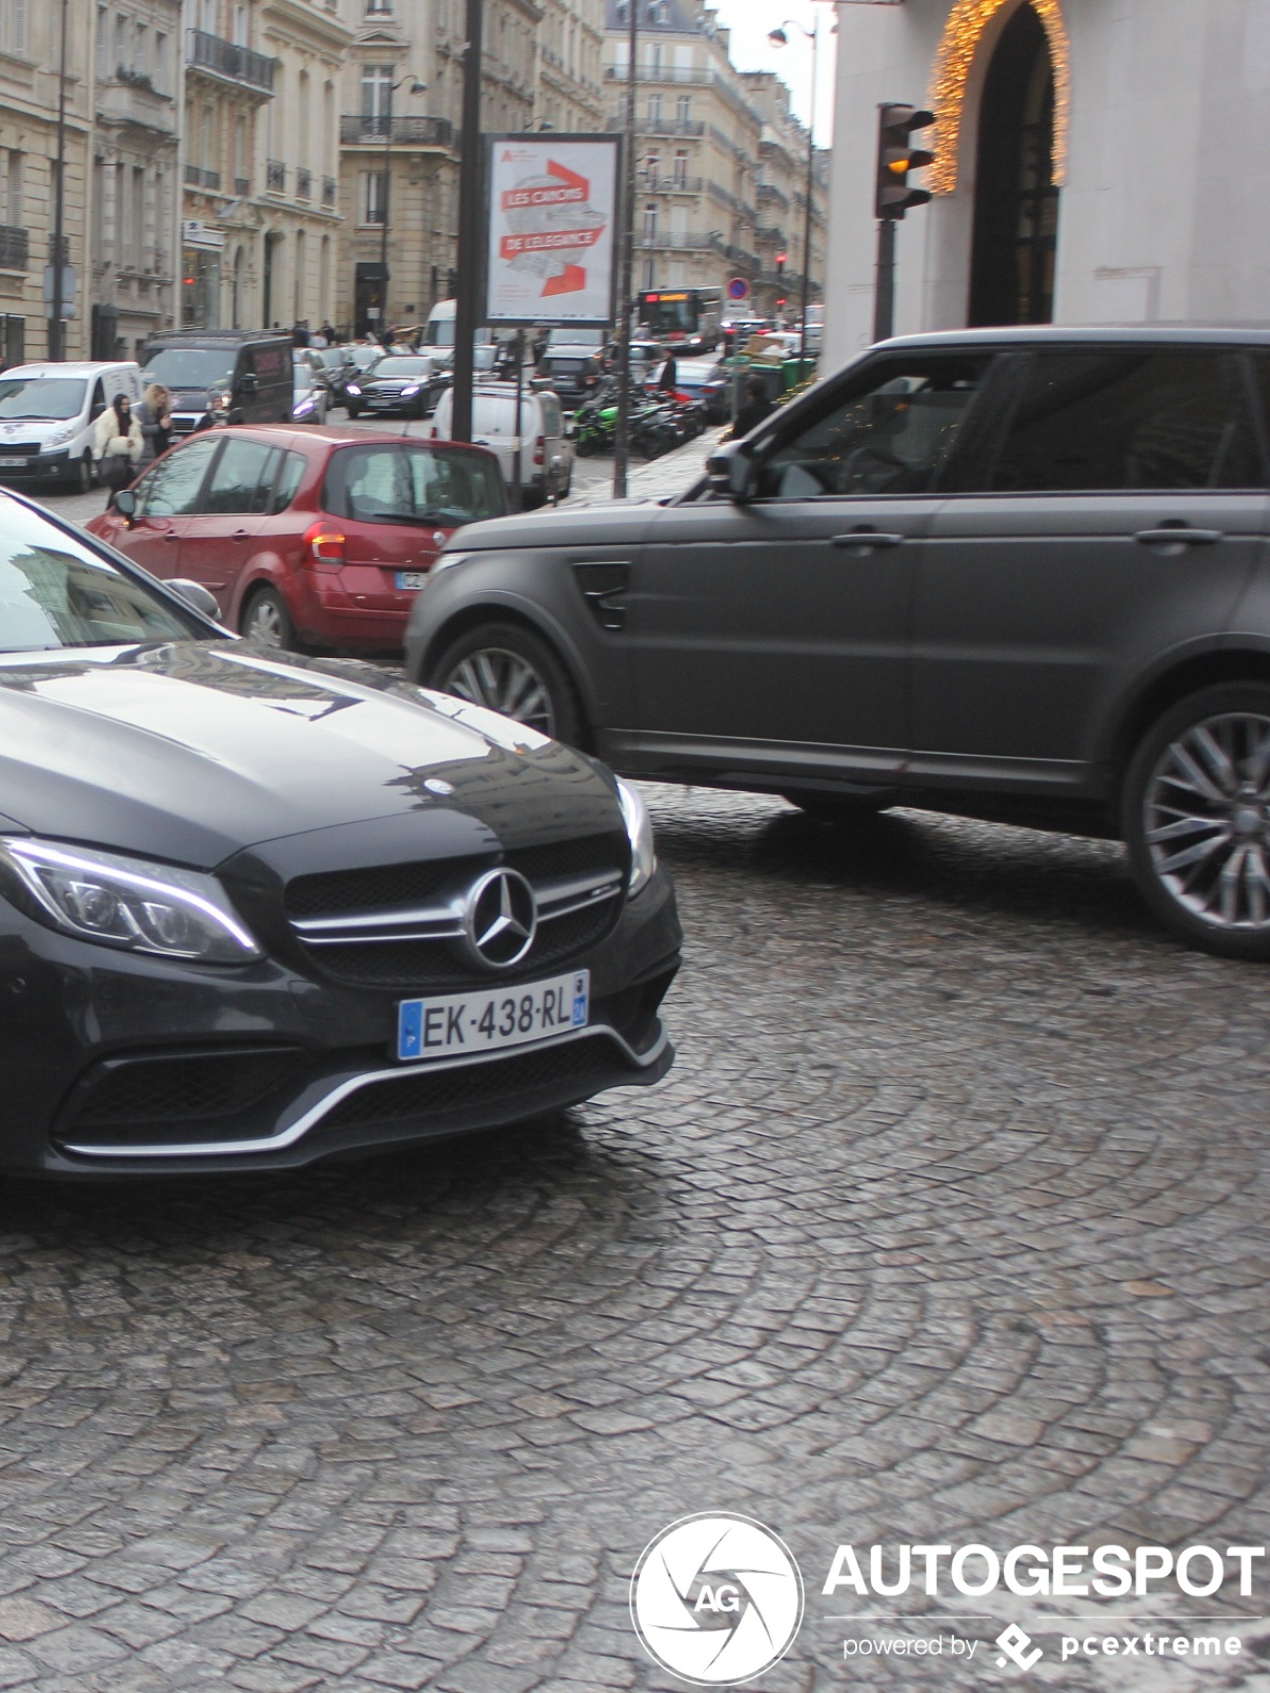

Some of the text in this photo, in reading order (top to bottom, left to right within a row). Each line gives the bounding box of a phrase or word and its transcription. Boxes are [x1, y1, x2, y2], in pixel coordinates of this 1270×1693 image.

[508, 187, 584, 206] LES CANONS
[506, 238, 523, 251] DE
